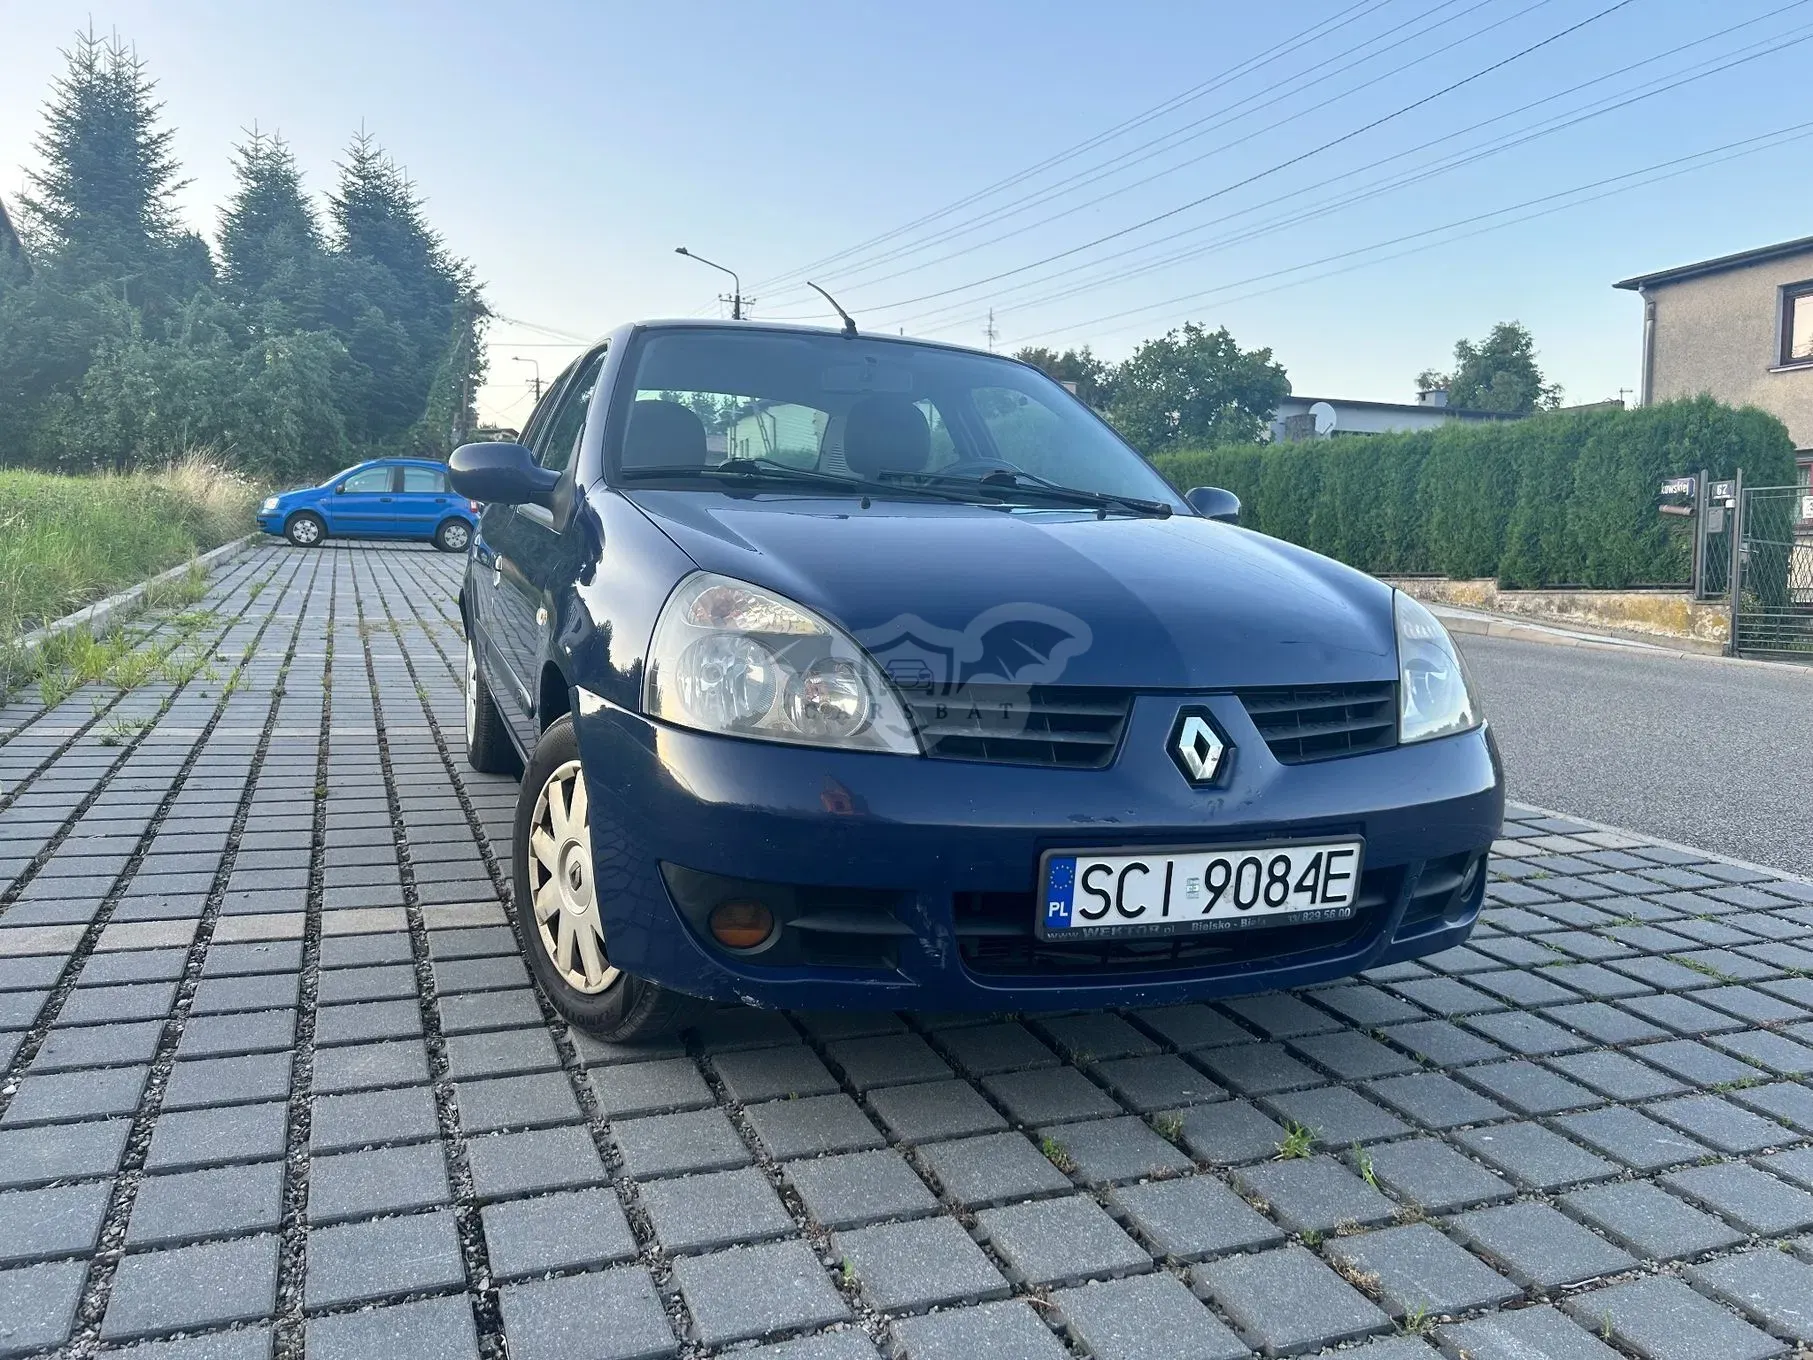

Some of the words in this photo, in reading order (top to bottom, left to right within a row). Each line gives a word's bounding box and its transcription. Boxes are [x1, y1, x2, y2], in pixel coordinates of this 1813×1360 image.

[1716, 484, 1728, 496] 62
[1078, 860, 1174, 920] SCI
[1201, 848, 1355, 915] 9084E
[1048, 901, 1069, 918] PL
[1191, 920, 1231, 932] Bielsko
